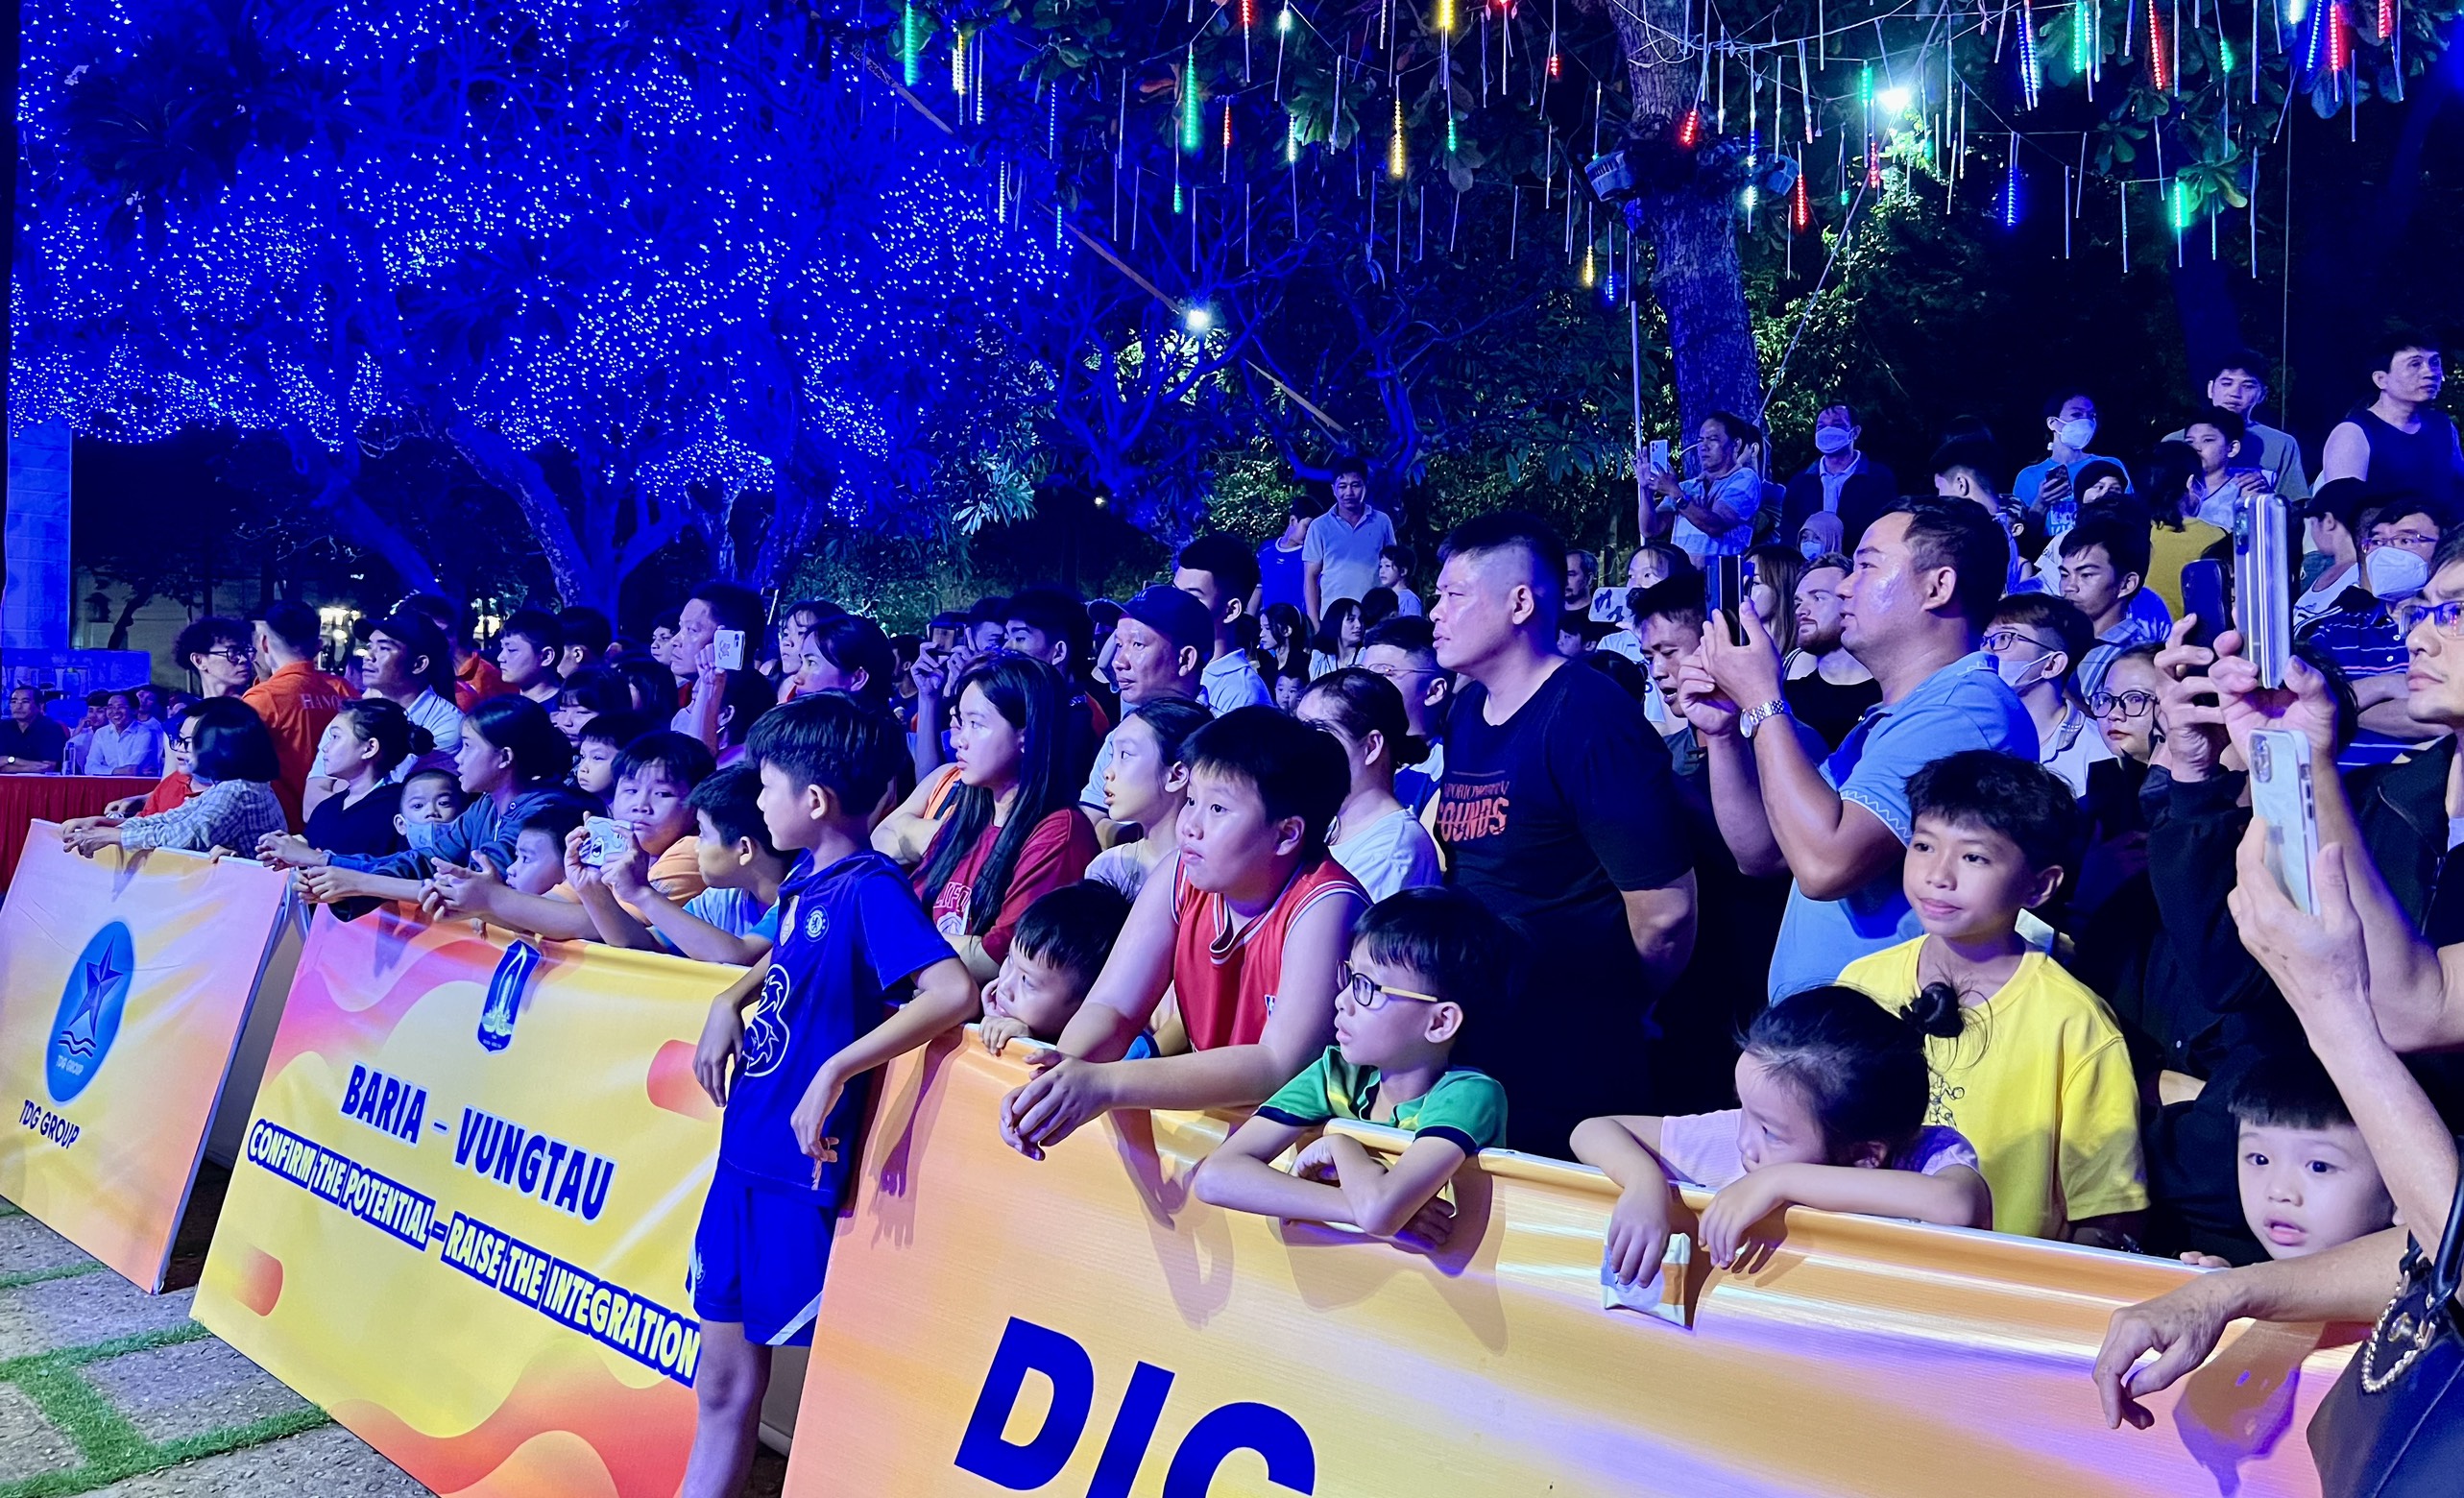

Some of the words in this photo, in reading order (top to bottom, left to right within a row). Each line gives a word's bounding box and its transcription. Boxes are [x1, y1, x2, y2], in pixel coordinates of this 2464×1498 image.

[300, 692, 341, 710] HANO
[19, 1099, 41, 1129] TDG
[39, 1111, 81, 1150] GROUP
[341, 1065, 427, 1144] BARIA
[454, 1107, 614, 1220] VUNGTAU
[250, 1125, 318, 1185] CONFIRM
[313, 1152, 347, 1198] THE
[343, 1168, 433, 1245] POTENTIAL
[445, 1219, 505, 1280] RAISE
[504, 1243, 546, 1298] THE
[544, 1263, 701, 1379] INTEGRATION
